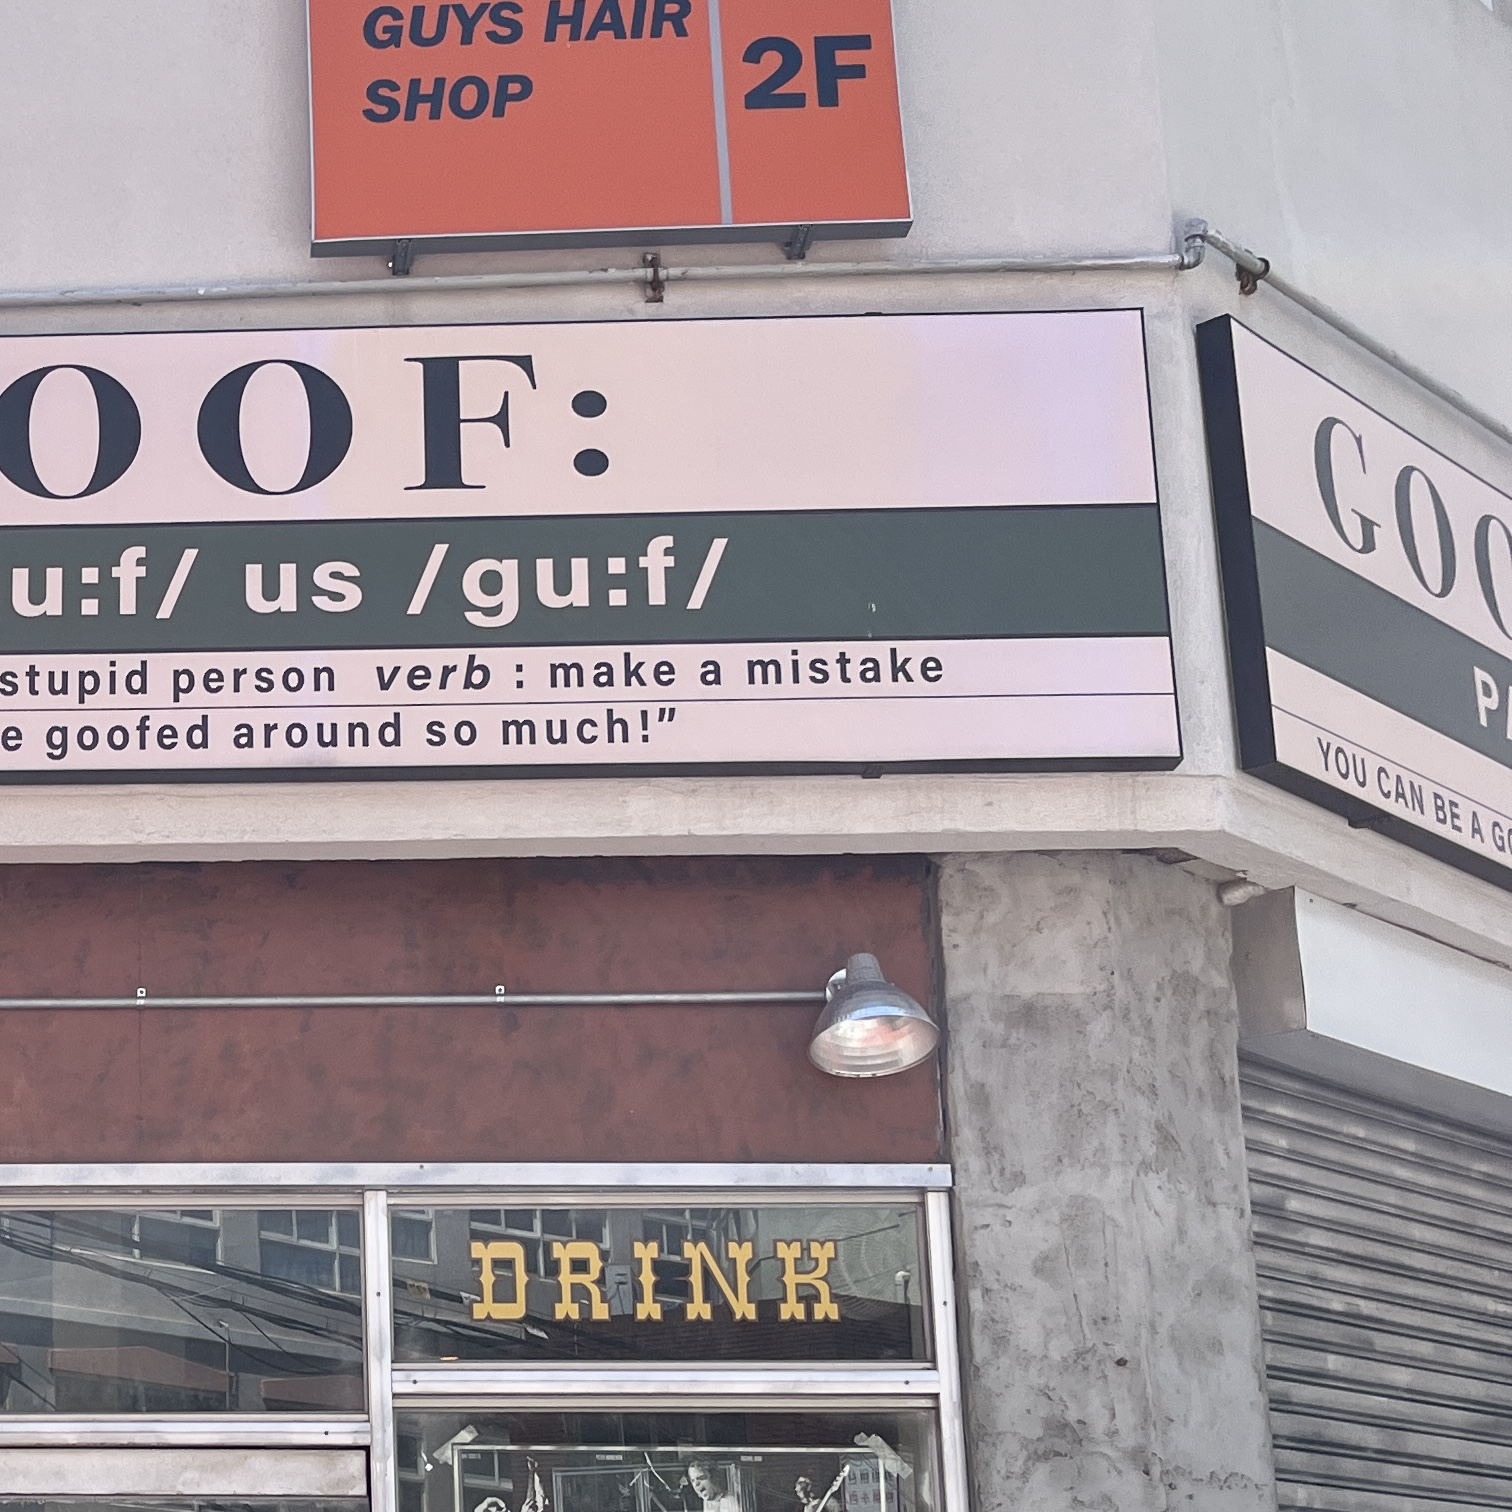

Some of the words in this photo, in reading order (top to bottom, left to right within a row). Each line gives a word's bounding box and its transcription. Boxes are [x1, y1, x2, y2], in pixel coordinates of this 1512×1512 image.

[362, 0, 524, 49] GUYS
[544, 0, 694, 43] HAIR
[362, 74, 535, 123] SHOP
[741, 34, 873, 111] 2F
[243, 561, 364, 614] us
[0, 659, 149, 703] stupid
[171, 662, 336, 703] person
[376, 653, 491, 692] verb
[548, 653, 676, 688] make
[698, 658, 723, 687] a
[745, 648, 944, 686] mistake
[1474, 666, 1512, 741] P
[45, 714, 210, 762] goofed
[232, 711, 401, 749] around
[425, 716, 477, 747] so
[1317, 736, 1367, 789] YOU
[1377, 766, 1425, 816] CAN
[1433, 792, 1463, 833] BE
[1471, 810, 1485, 844] A
[469, 1239, 841, 1323] DRINK
